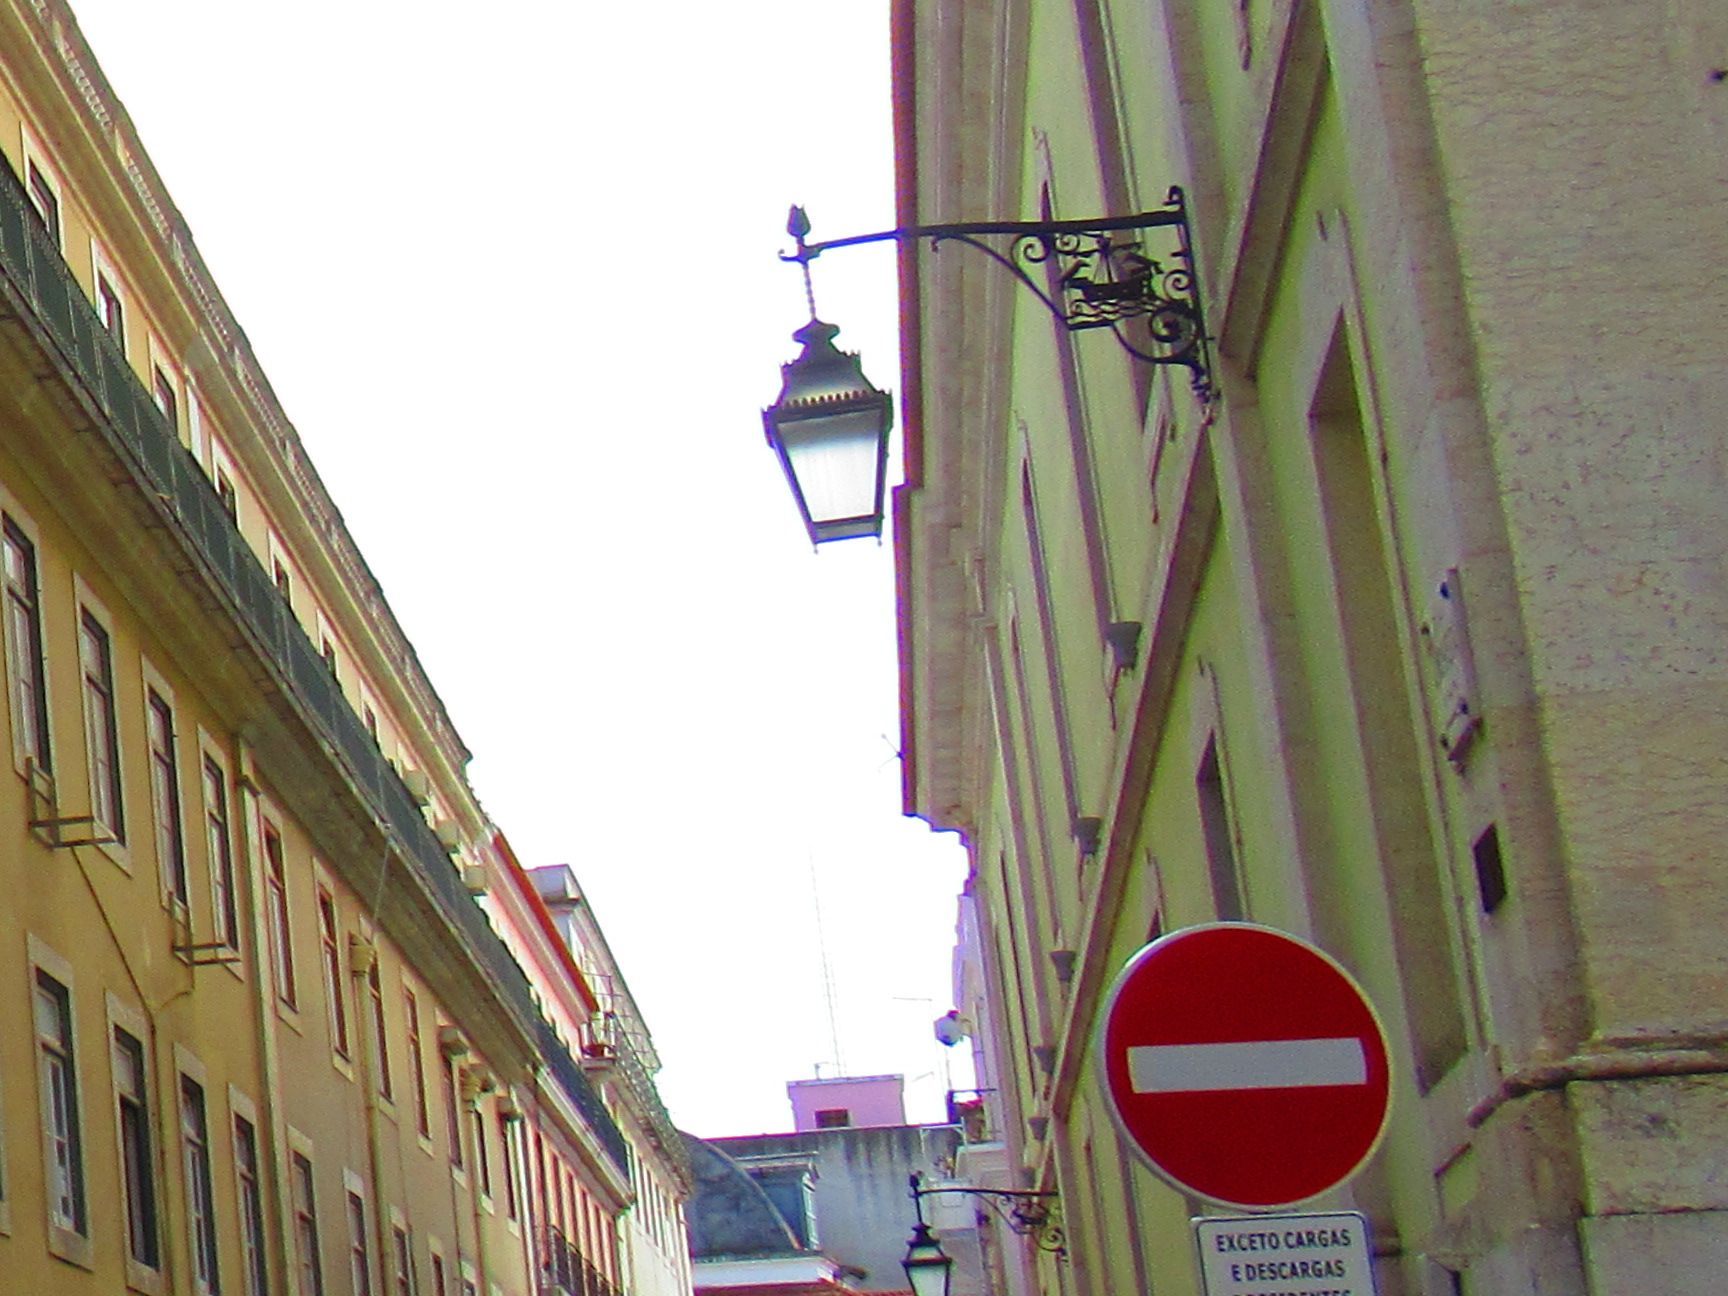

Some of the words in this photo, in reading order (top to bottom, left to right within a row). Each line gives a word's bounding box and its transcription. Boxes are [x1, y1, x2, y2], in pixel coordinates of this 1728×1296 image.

[1216, 1232, 1281, 1253] EXCETO
[1284, 1229, 1352, 1250] CARGAS
[1232, 1263, 1242, 1283] E
[1246, 1261, 1346, 1281] DESCARGAS
